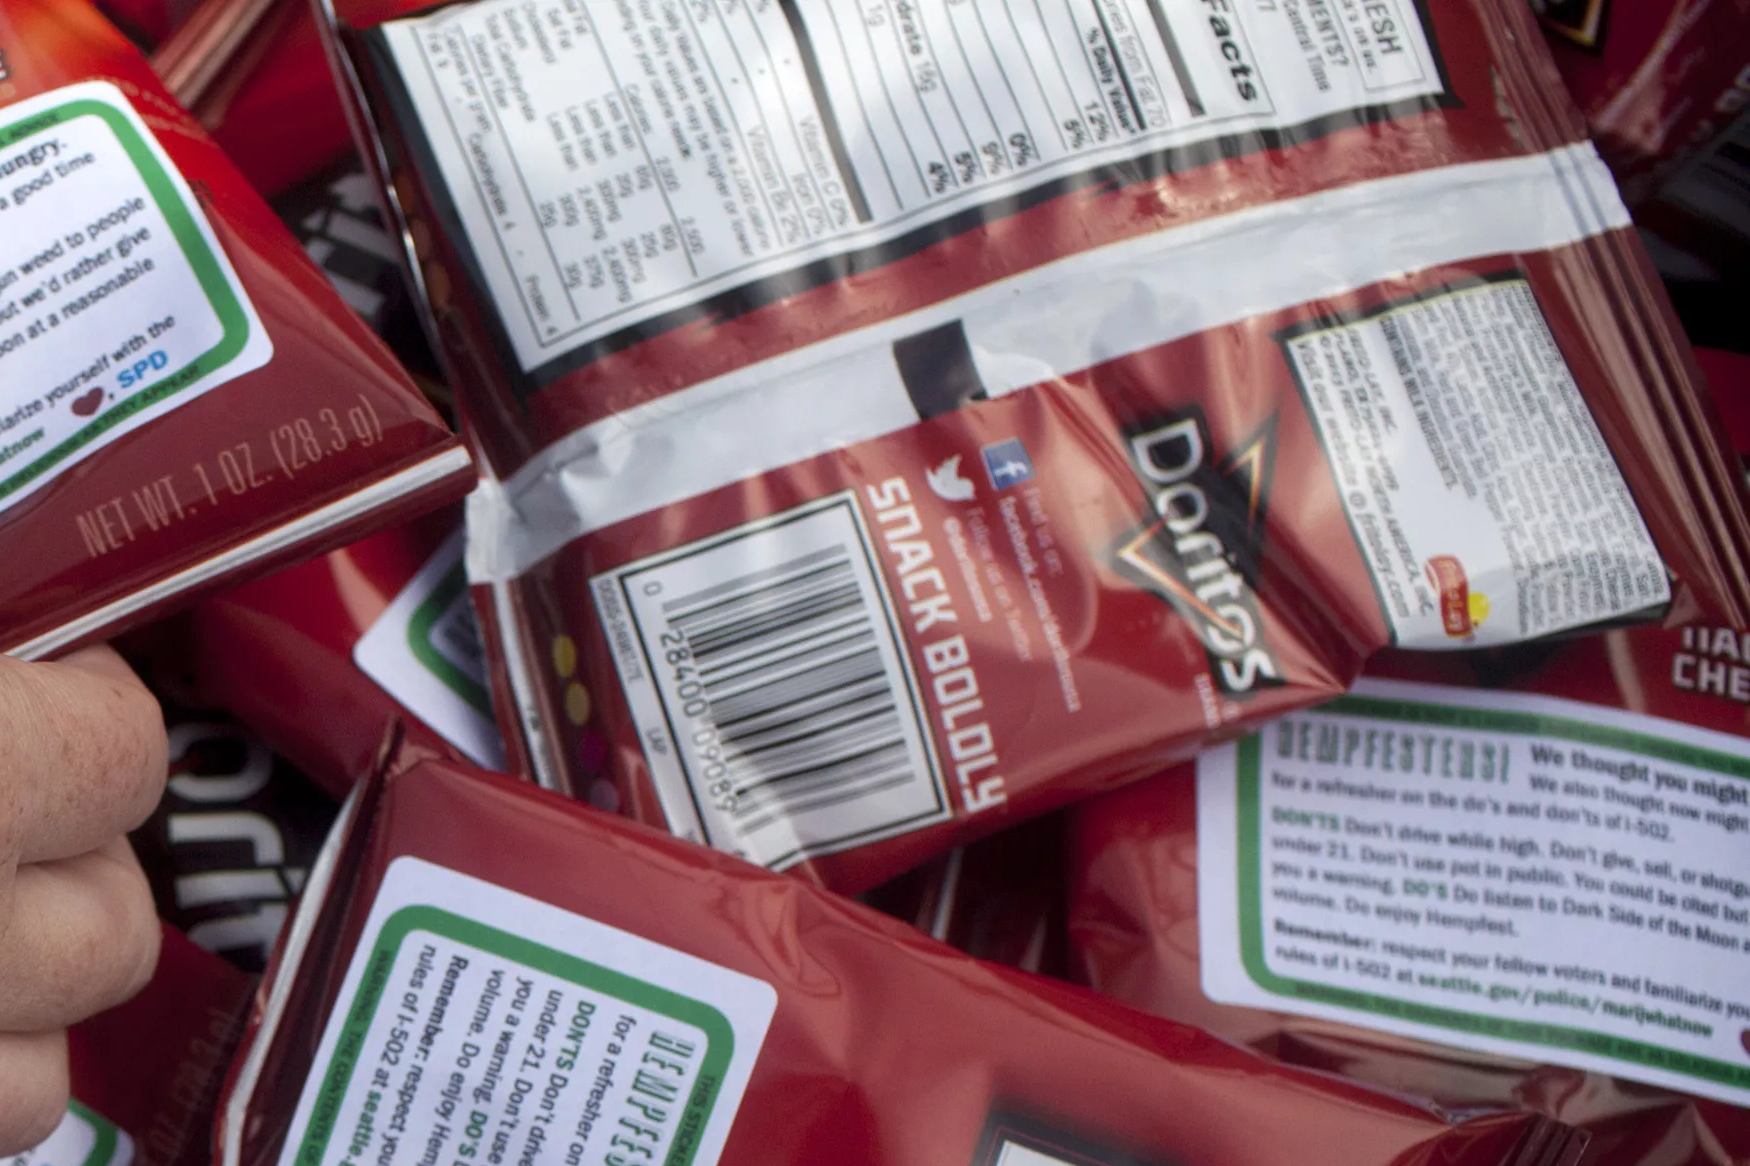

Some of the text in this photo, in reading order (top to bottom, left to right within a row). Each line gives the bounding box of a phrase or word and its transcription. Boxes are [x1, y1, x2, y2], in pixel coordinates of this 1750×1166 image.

[115, 349, 170, 389] SPD
[75, 392, 385, 559] NET WT. 1 OZ. (28.3 g)
[1130, 416, 1278, 694] Doritos
[659, 628, 709, 720] 28400
[866, 477, 959, 633] SNACK
[923, 636, 1008, 813] BOLDLY
[414, 954, 470, 1063] Remember:
[388, 1063, 425, 1134] respect
